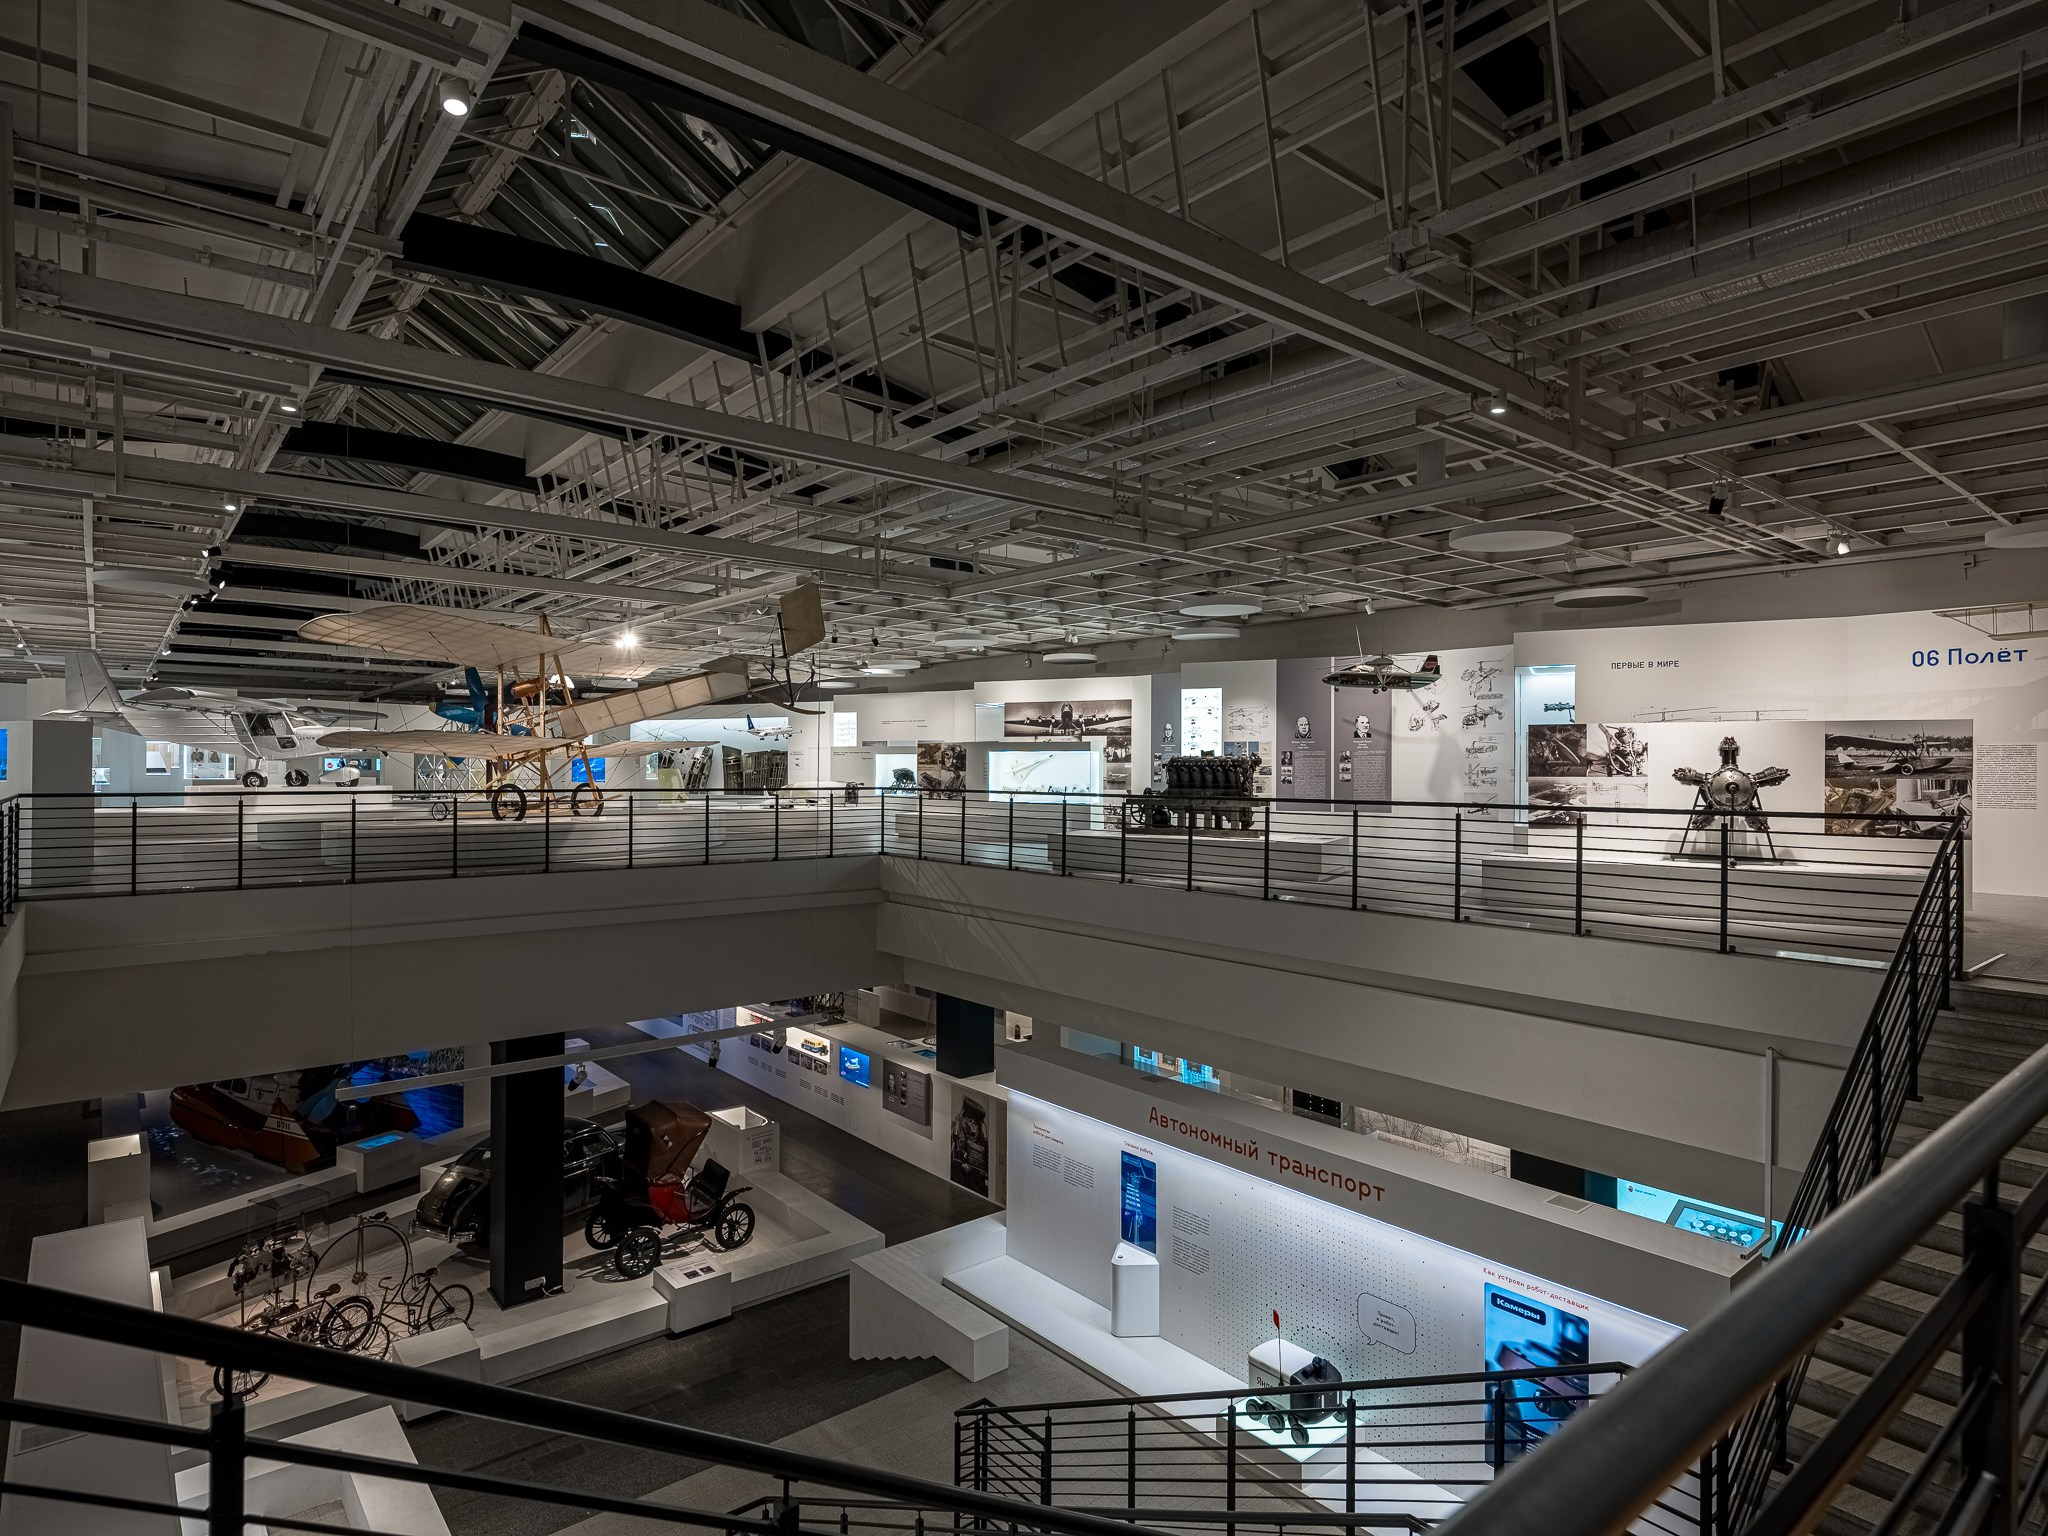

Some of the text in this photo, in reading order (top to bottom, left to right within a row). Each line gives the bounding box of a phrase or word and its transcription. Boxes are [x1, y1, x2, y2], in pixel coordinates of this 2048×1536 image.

[1611, 660, 1680, 670] ПЕРВЫЕ В МИРЕ
[1911, 647, 2029, 668] 06 Полёт
[1149, 1106, 1386, 1202] Автономный транспорт
[1482, 1266, 1590, 1312] Как устроен робот-доставщик
[1496, 1297, 1540, 1321] Камеры
